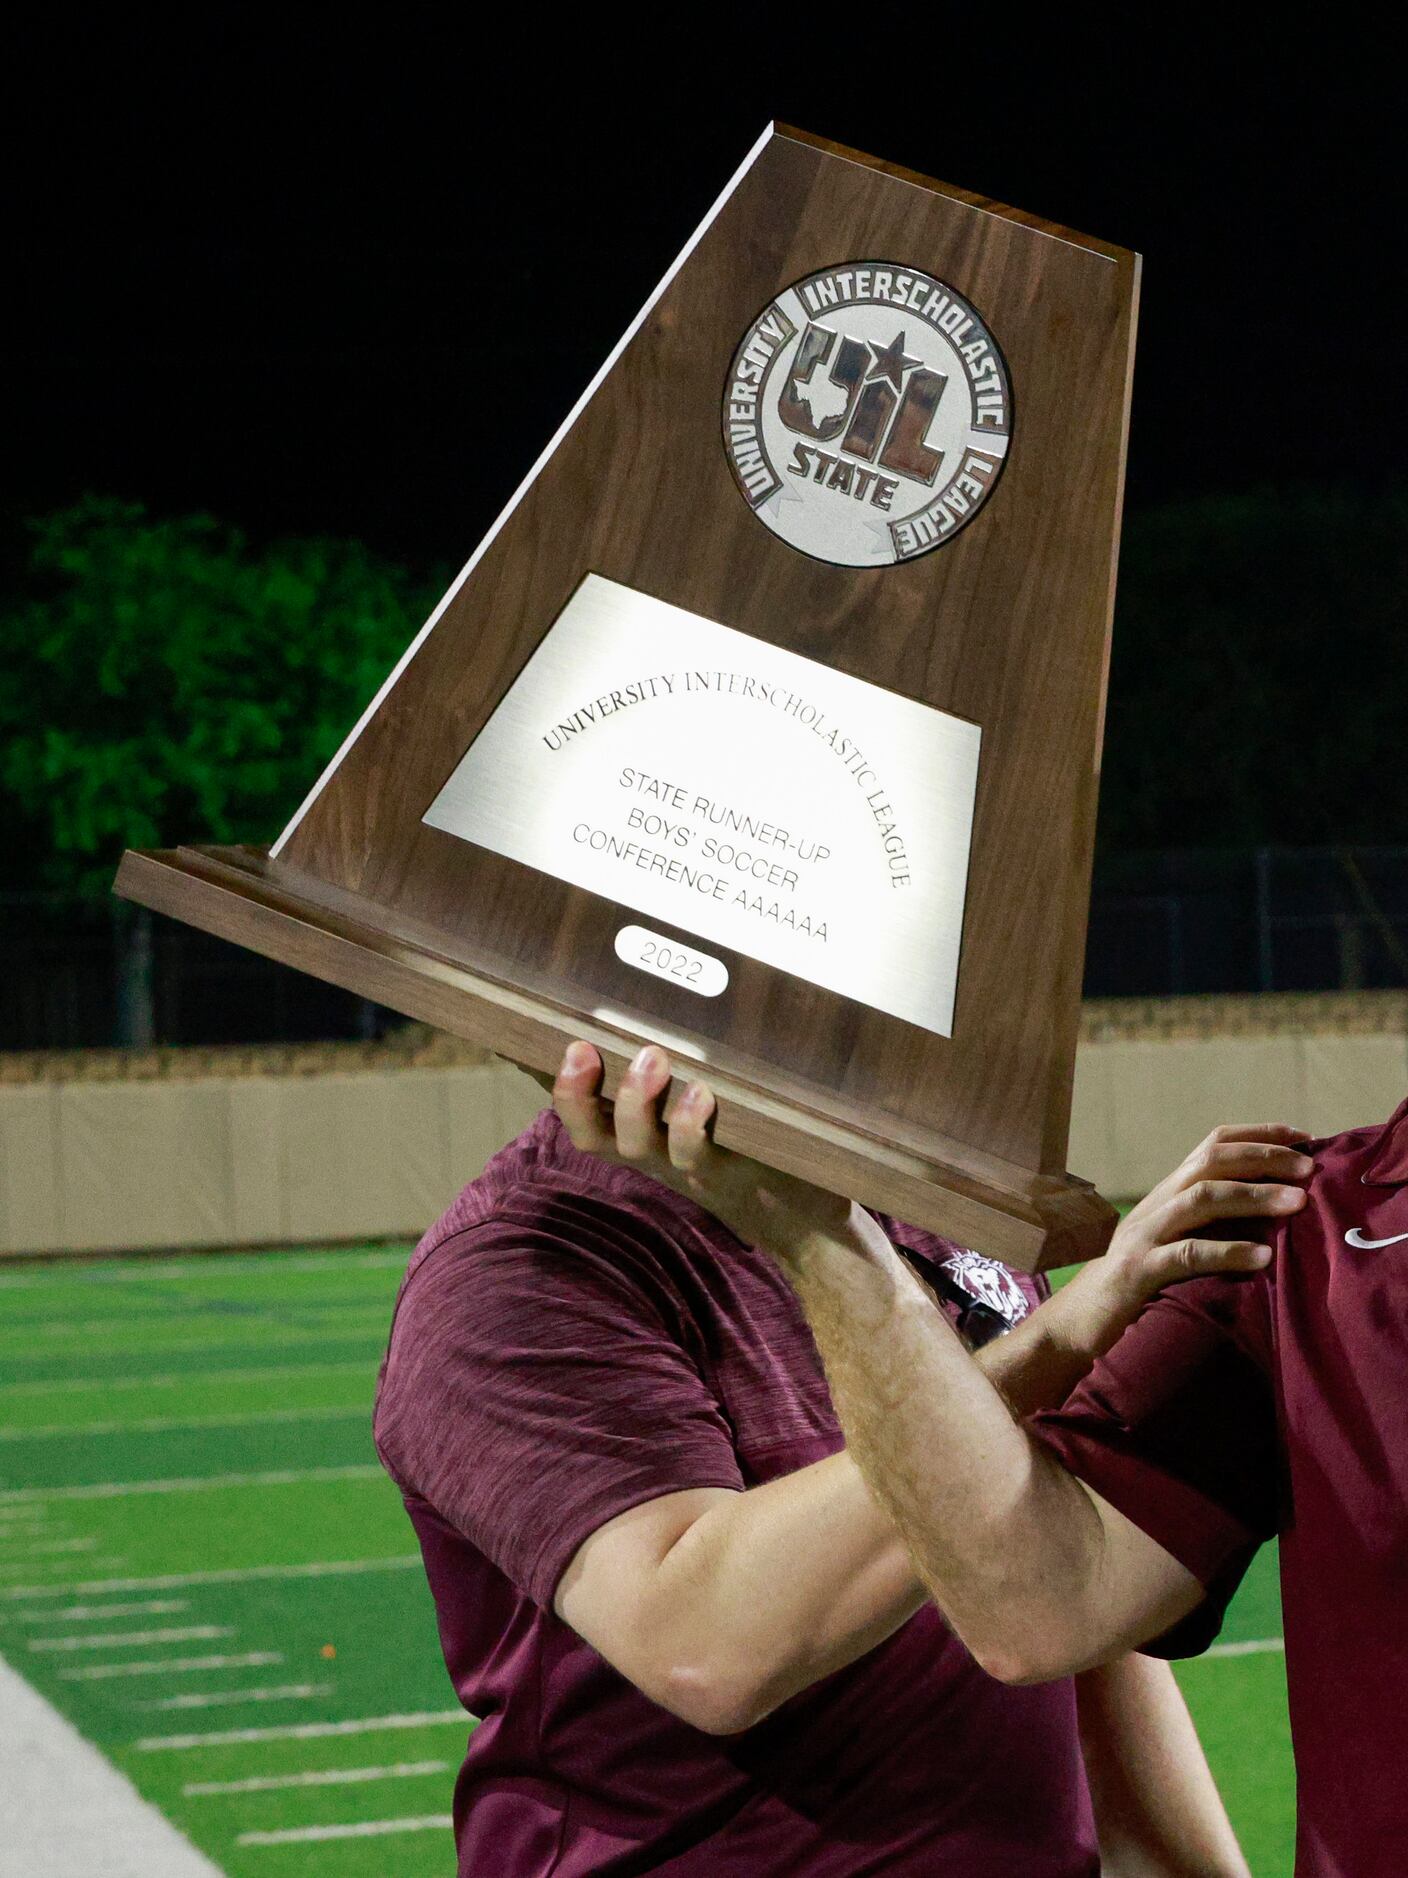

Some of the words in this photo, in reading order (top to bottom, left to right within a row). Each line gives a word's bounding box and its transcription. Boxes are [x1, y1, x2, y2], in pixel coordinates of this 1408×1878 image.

[777, 320, 949, 489] UIL
[803, 271, 1005, 427] INTERSCHOLASTIC
[728, 311, 789, 499] UNIVERSITY
[787, 440, 900, 512] STATE
[895, 455, 995, 555] LEAGUE
[542, 673, 677, 752] UNIVERSITY
[685, 670, 878, 790] INTERSCHOLASTIC
[867, 787, 912, 889] LEAGUE
[619, 766, 687, 811] STATE
[692, 794, 831, 865] RUNNER-UP
[572, 822, 731, 902] CONFERENCE
[731, 888, 830, 944] AAAAAA
[702, 836, 799, 893] SOCCER
[639, 940, 704, 985] 2022
